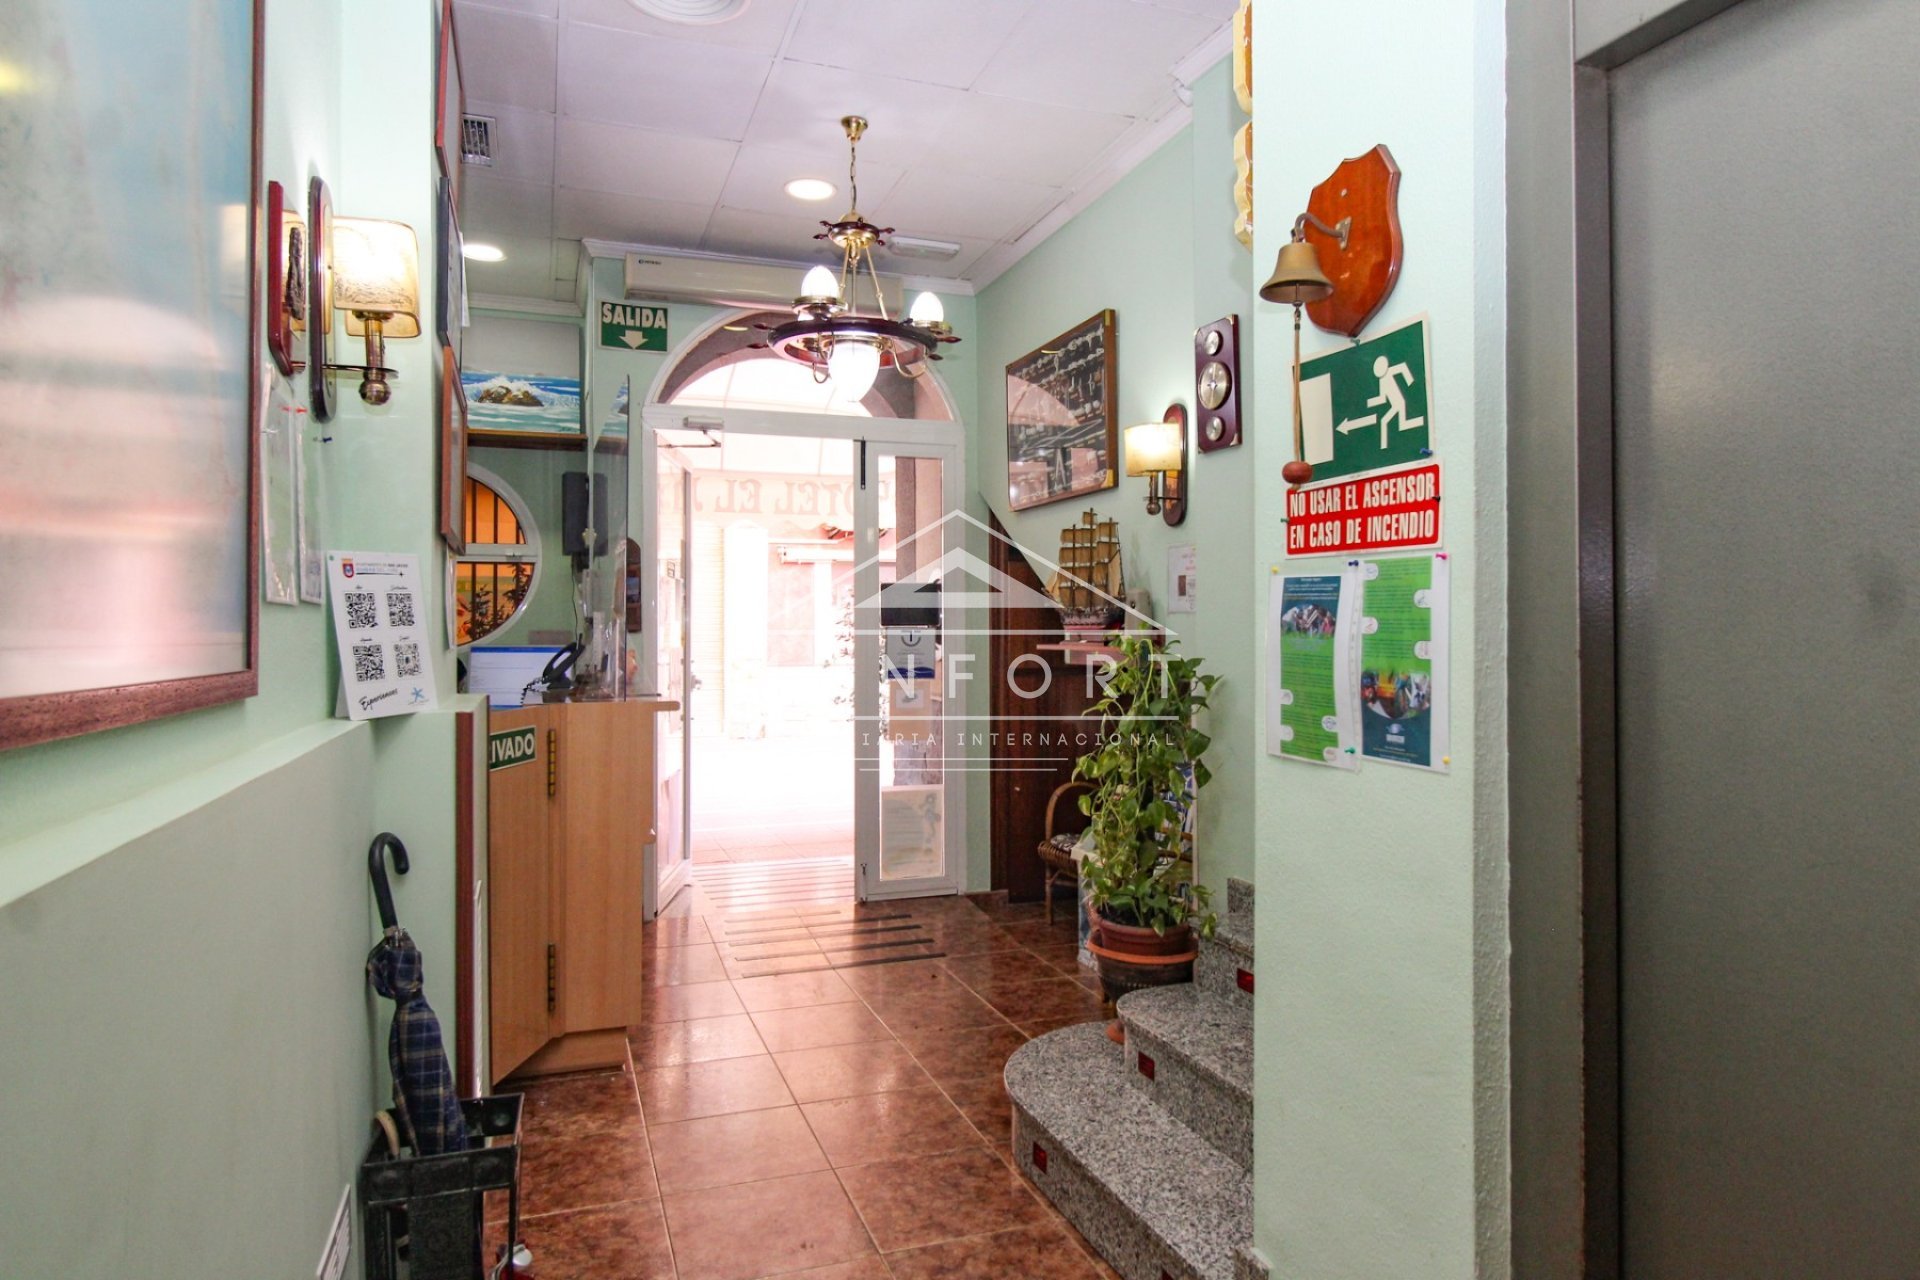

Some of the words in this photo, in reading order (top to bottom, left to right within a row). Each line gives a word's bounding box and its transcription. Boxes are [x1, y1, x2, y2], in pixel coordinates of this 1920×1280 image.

[602, 303, 667, 329] SALIDA
[1289, 493, 1306, 517] NO
[1310, 487, 1341, 515] USAR
[1345, 484, 1359, 511] EL
[1362, 472, 1435, 508] ASCENSOR
[1290, 524, 1305, 549] EN
[1309, 519, 1341, 547] CASO
[1346, 517, 1361, 544] DE
[1367, 509, 1435, 543] INCENDIO
[491, 733, 535, 763] IVADO
